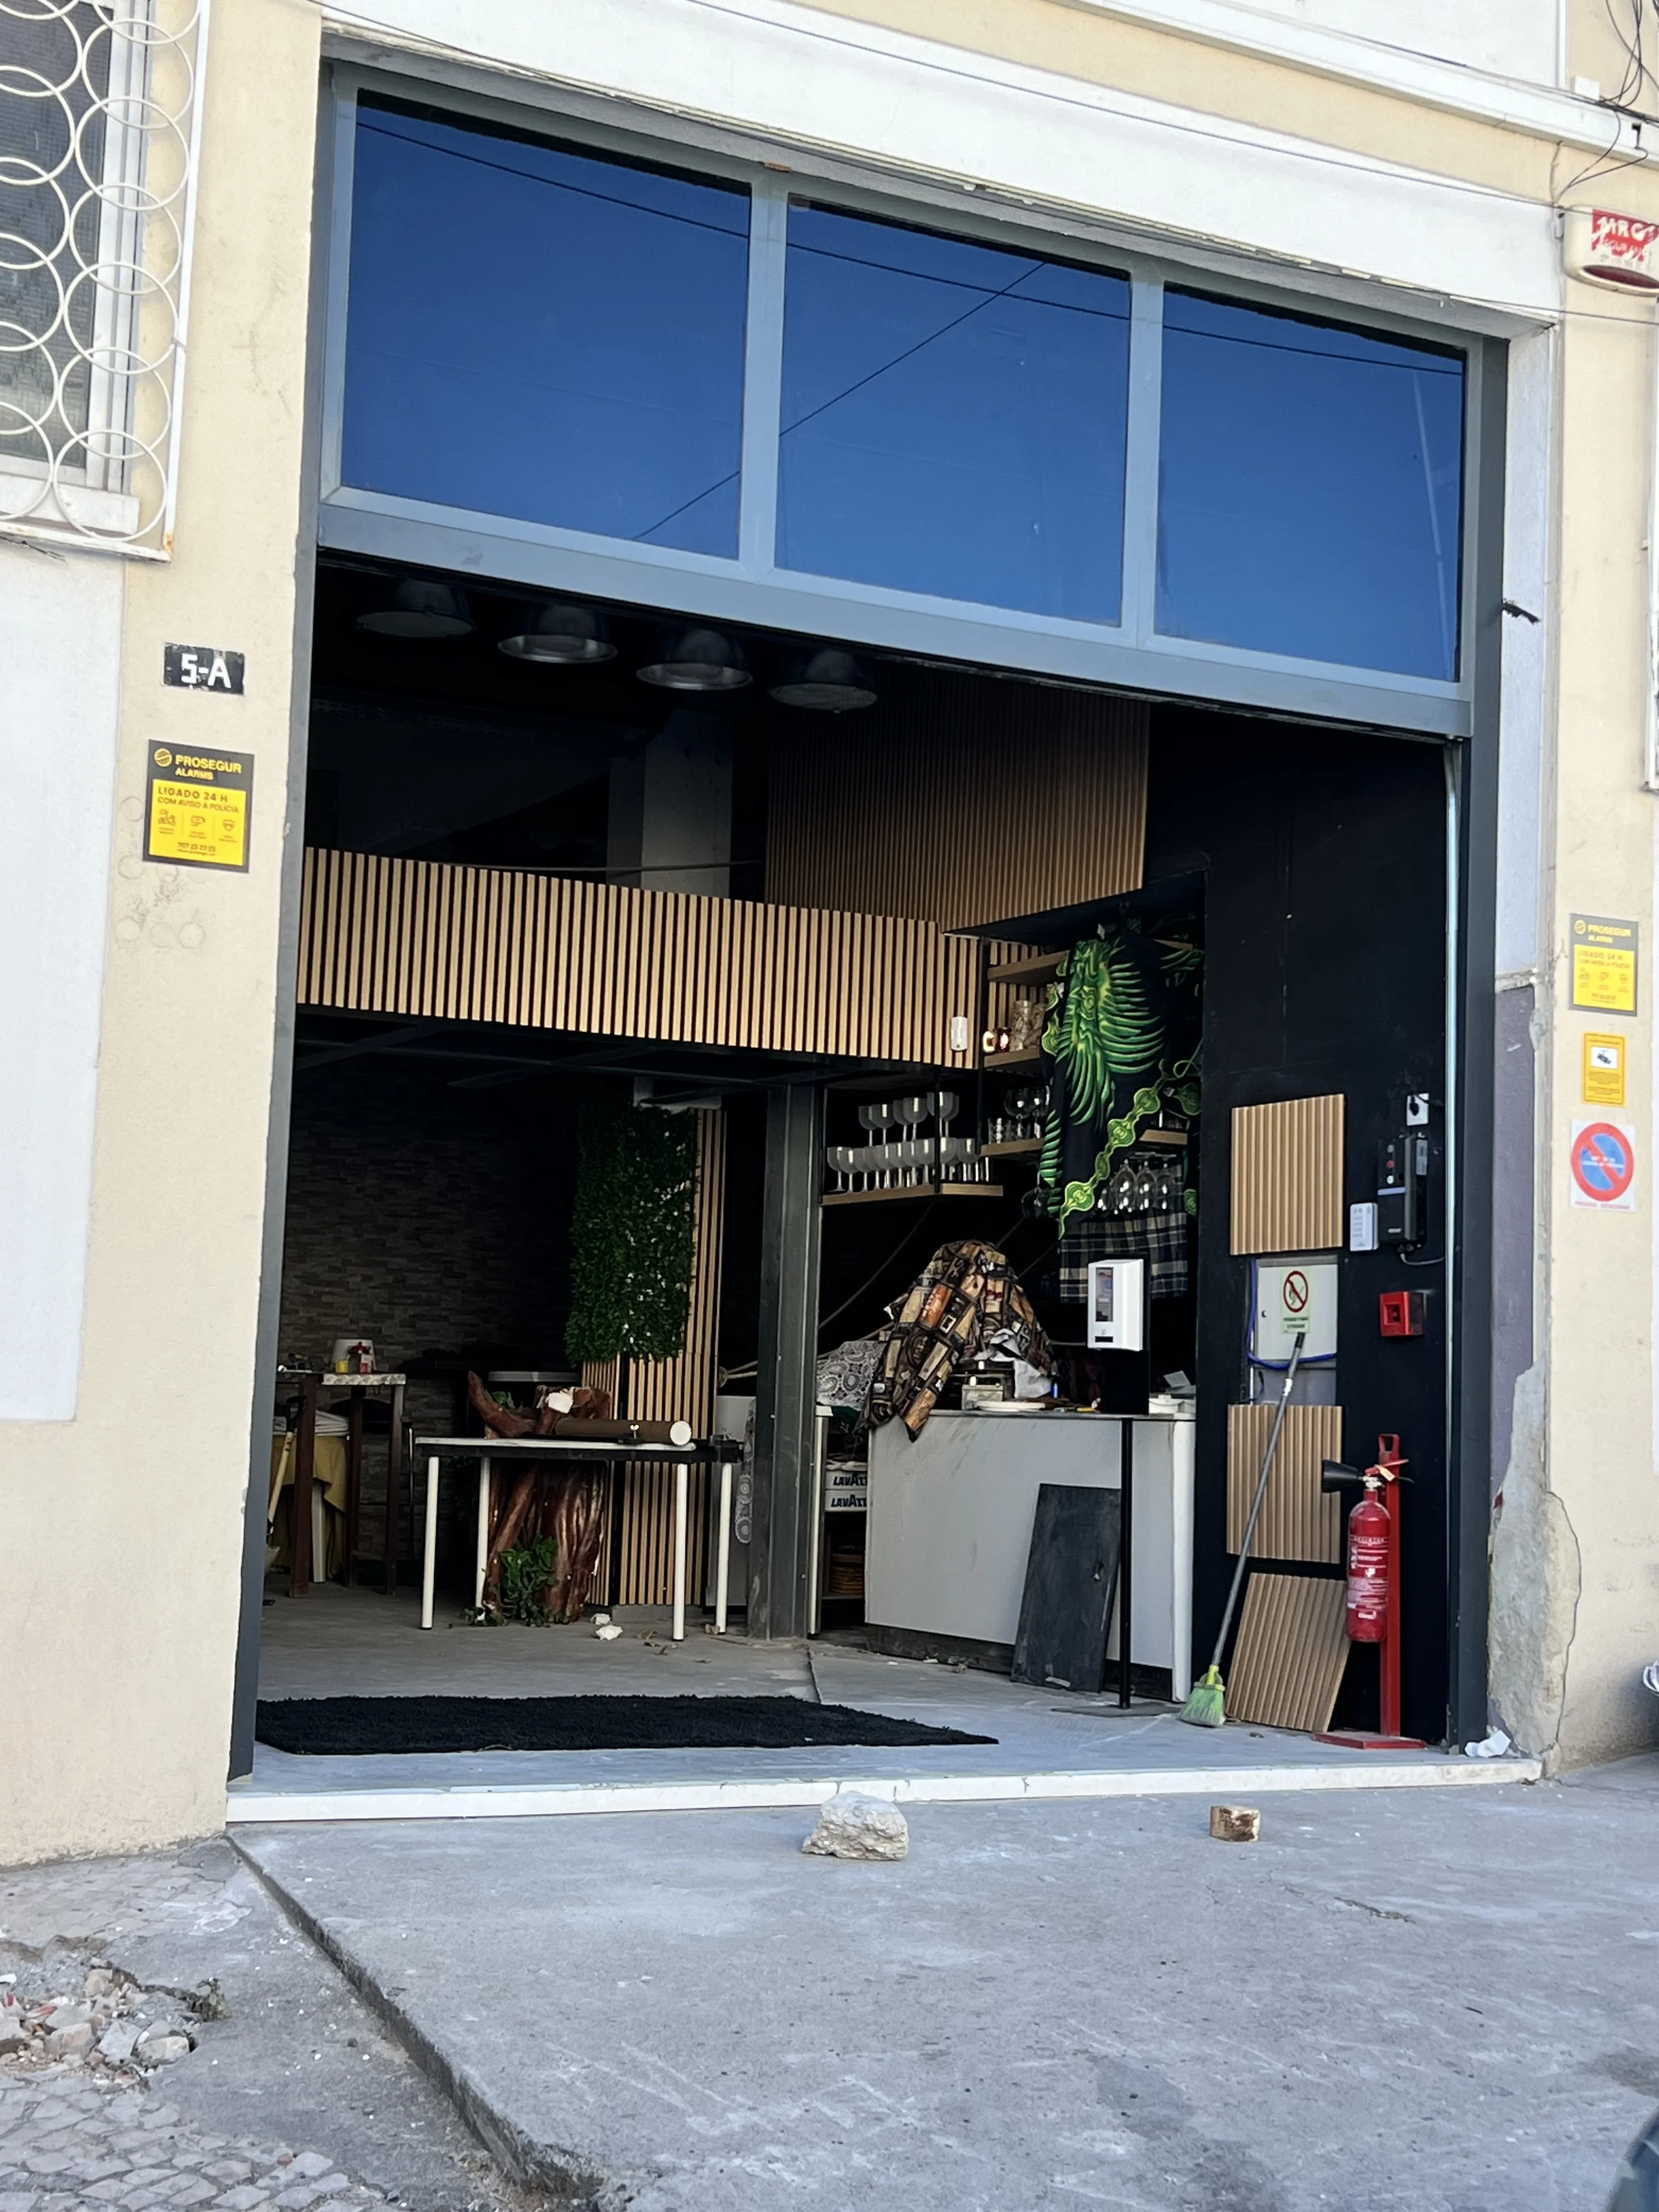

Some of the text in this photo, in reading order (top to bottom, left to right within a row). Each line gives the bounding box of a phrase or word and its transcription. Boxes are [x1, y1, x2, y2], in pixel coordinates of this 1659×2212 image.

[181, 653, 232, 689] 5-A
[175, 754, 242, 774] PROSEGUR
[175, 767, 214, 780] ALARMS
[157, 786, 228, 803] LIGADO 24 H
[157, 797, 177, 805] COM
